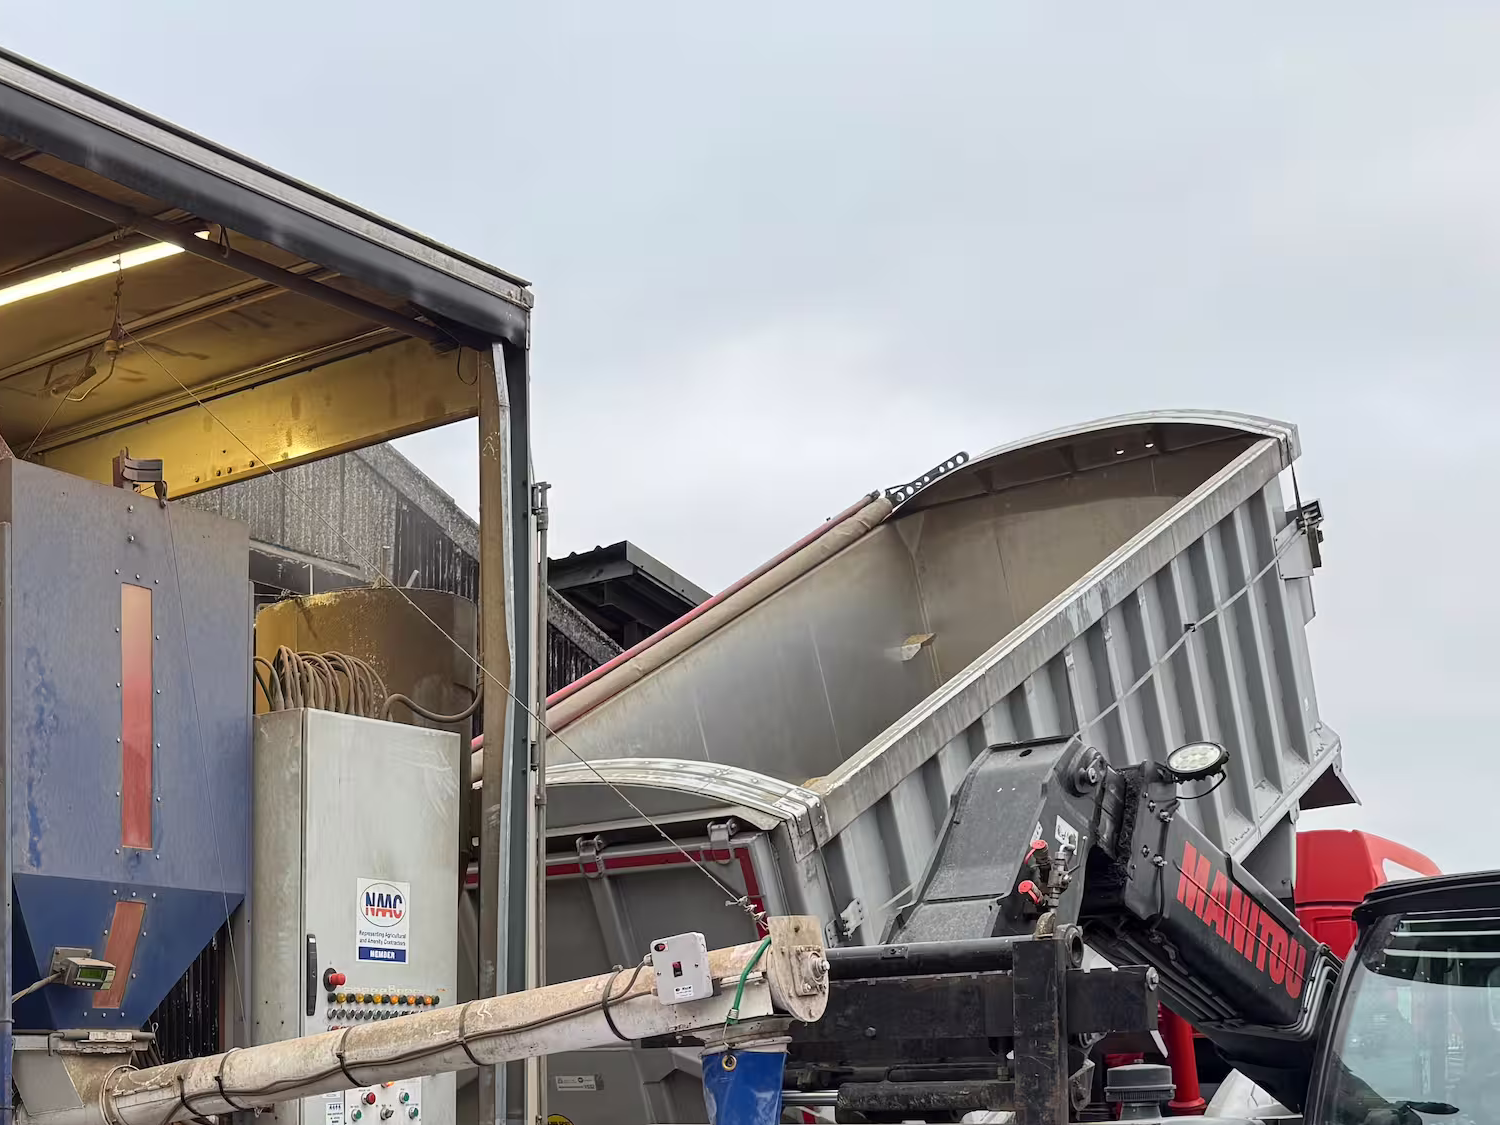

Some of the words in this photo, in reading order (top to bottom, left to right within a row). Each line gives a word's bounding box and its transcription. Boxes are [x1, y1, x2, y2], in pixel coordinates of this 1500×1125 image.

[366, 892, 402, 918] NAAC
[1176, 840, 1307, 999] MANITOU
[359, 930, 385, 938] Representing
[370, 950, 395, 959] MEMBER
